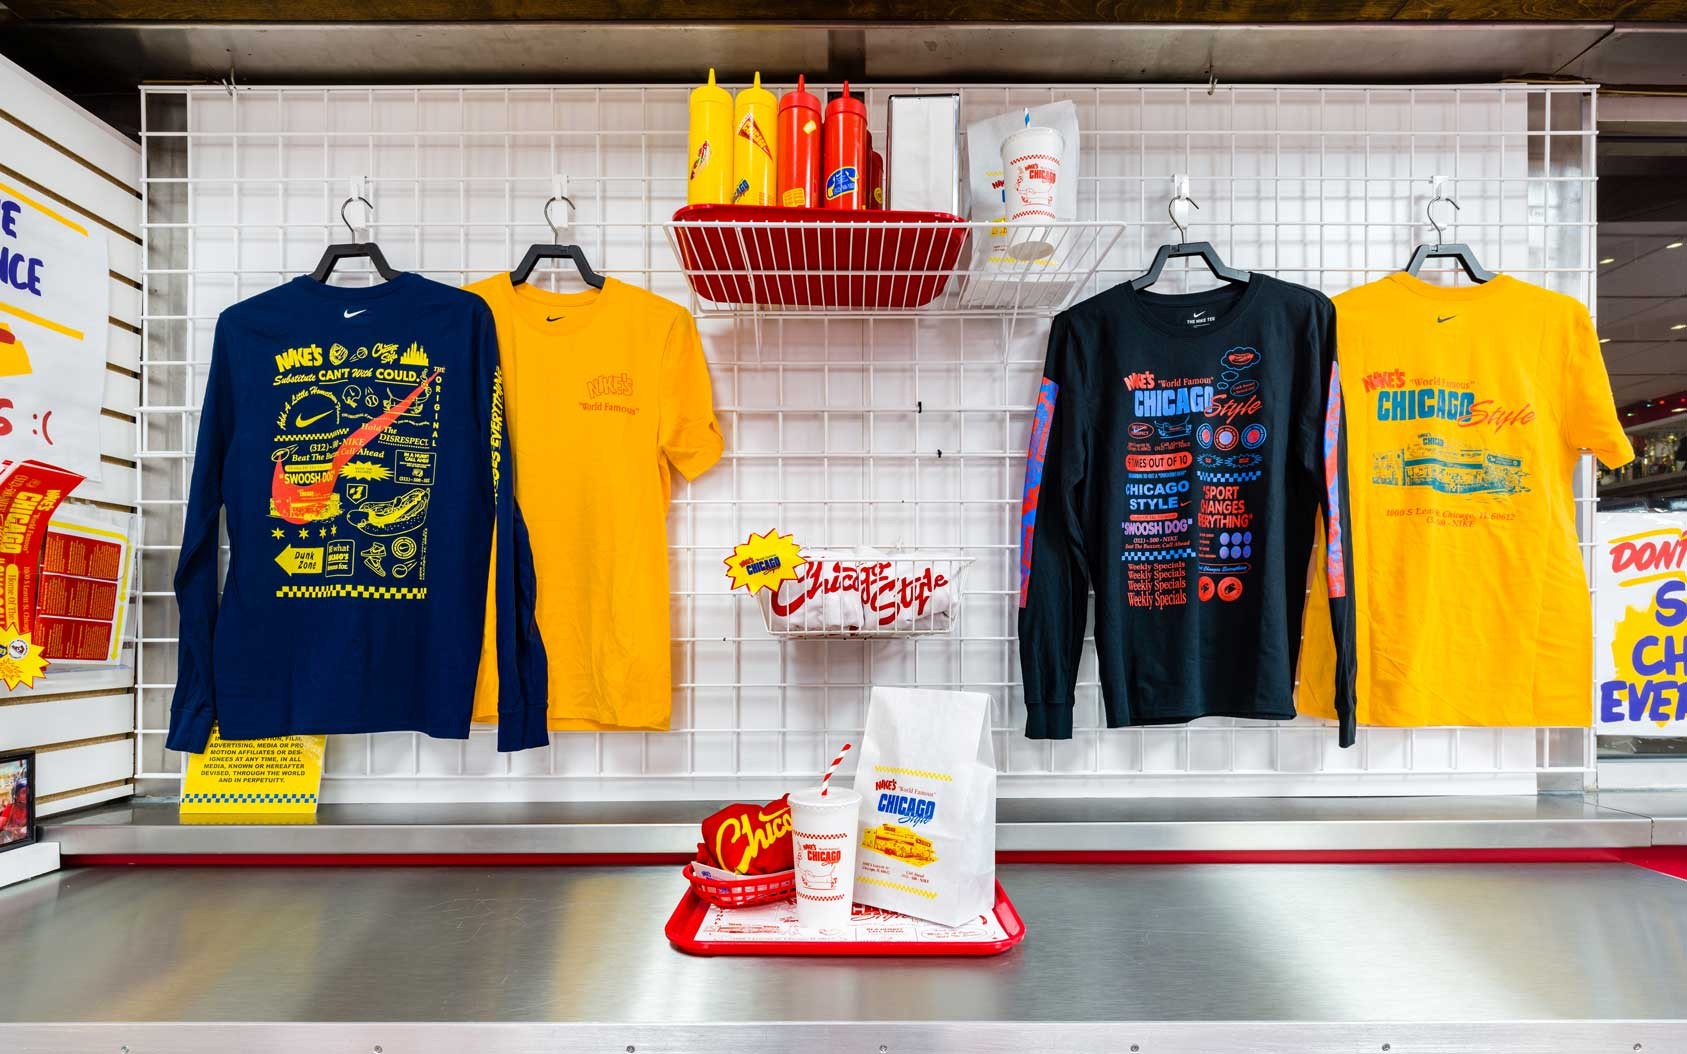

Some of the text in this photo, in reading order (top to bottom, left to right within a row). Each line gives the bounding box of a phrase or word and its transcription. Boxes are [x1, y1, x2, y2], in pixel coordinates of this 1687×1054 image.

[275, 344, 323, 373] NIKE'S
[273, 367, 420, 386] Substitute CAN'T With COULD.
[1124, 371, 1155, 391] NIKE'S
[1362, 368, 1405, 393] NIKE'S
[587, 373, 634, 399] NIKE'S
[1134, 386, 1262, 424] CHICAGO Style
[1376, 388, 1536, 433] CHICAGO Style
[361, 422, 398, 434] Hold The
[379, 433, 430, 446] DISRESPECT
[292, 453, 310, 462] Beat
[312, 452, 324, 460] The
[357, 447, 385, 458] Ahead
[1148, 458, 1165, 468] OUT
[1166, 456, 1177, 467] OF
[1179, 455, 1188, 465] 10
[1125, 480, 1190, 496] CHICAGO
[1129, 496, 1178, 511] STYLE
[1164, 518, 1193, 534] DOG"
[295, 551, 315, 560] Dunk
[298, 560, 317, 570] Zone
[746, 556, 781, 575] CHICAGO
[1128, 561, 1185, 571] Weekly Specials
[1128, 568, 1185, 580] Weekly Specials
[8, 575, 16, 595] Home
[1128, 578, 1186, 591] Weekly Specials
[871, 567, 949, 626] Style
[1128, 590, 1187, 608] Weekly Specials
[876, 779, 897, 791] NIKE'S
[877, 793, 936, 820] CHICAGO
[807, 850, 841, 864] CHICAGO
